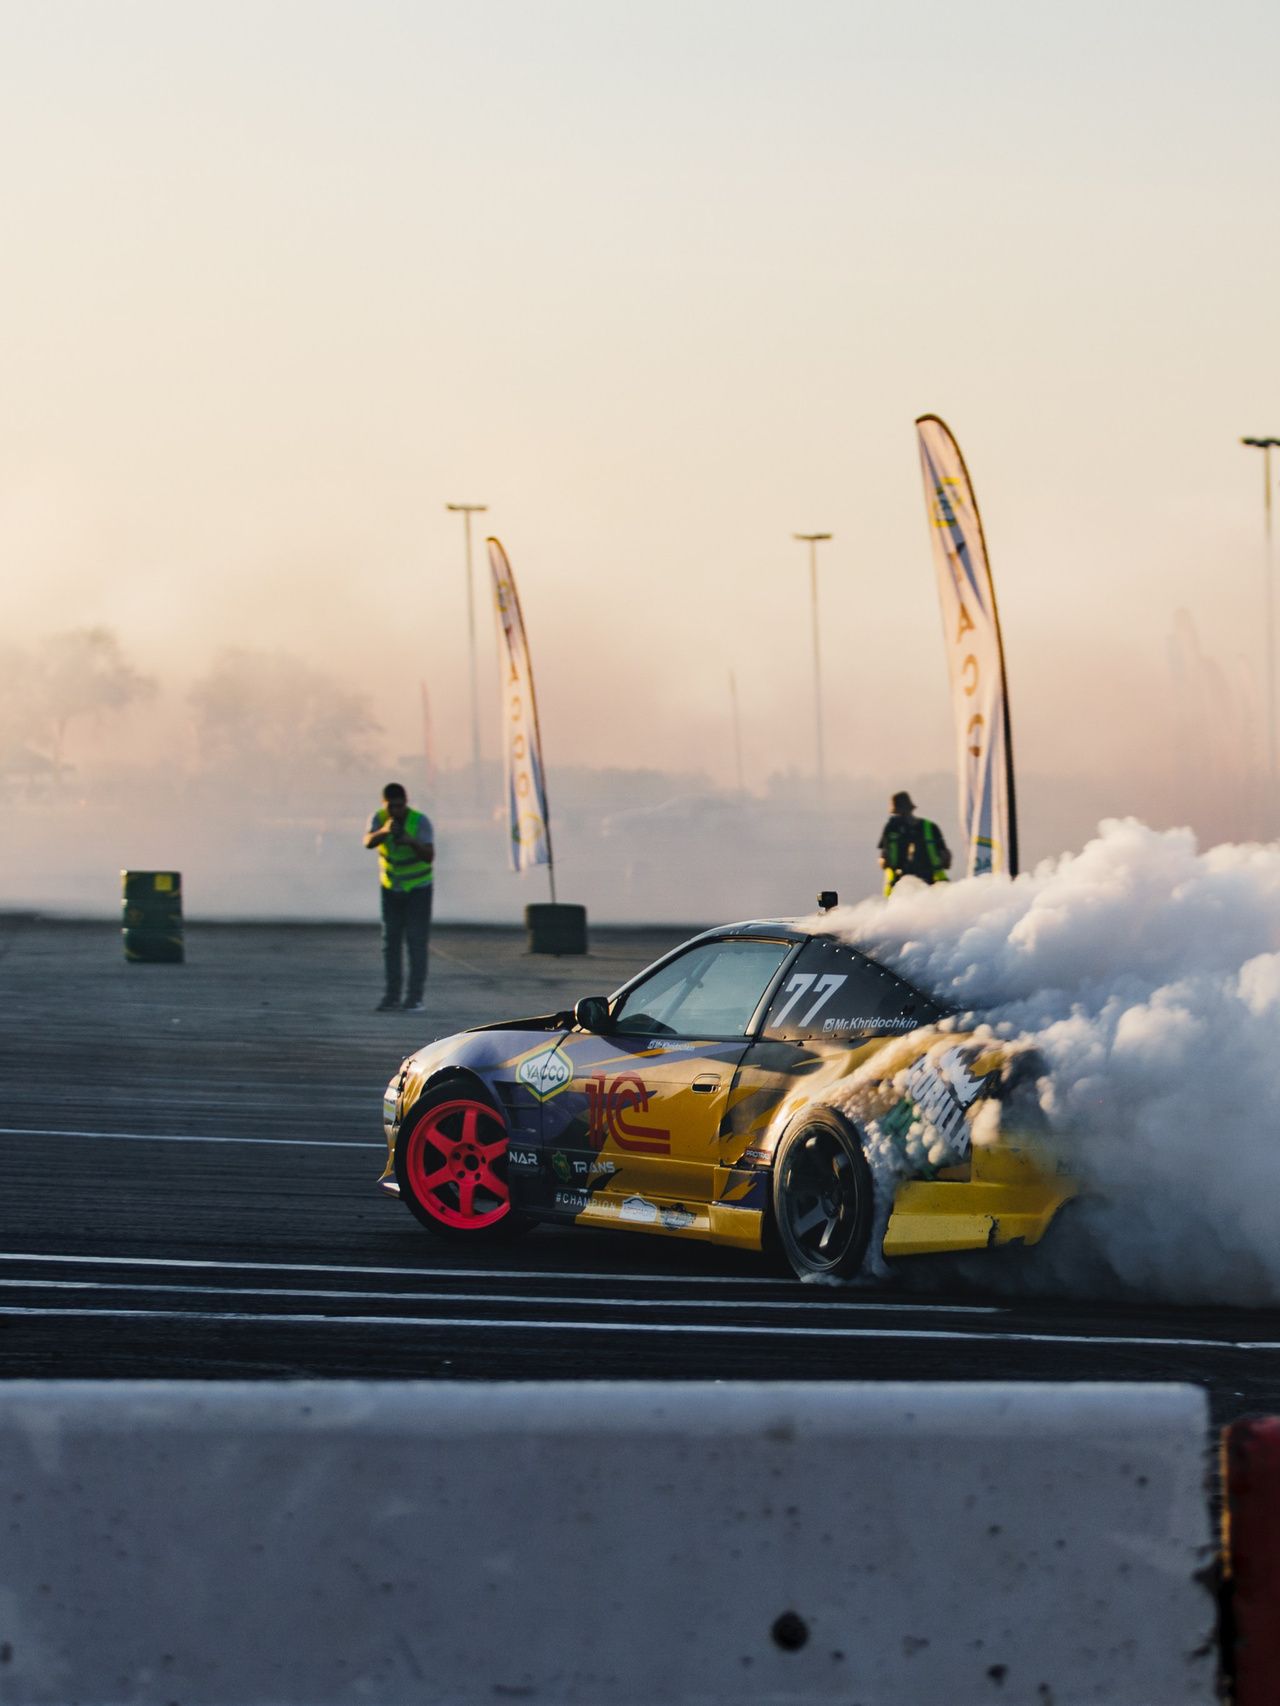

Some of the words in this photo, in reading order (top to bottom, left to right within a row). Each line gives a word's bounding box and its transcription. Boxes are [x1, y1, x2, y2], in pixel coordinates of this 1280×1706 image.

[771, 973, 848, 1027] 77
[834, 1017, 918, 1030] Mr.Khridochkin
[527, 1064, 565, 1082] YACCO
[573, 1161, 615, 1173] TRANS
